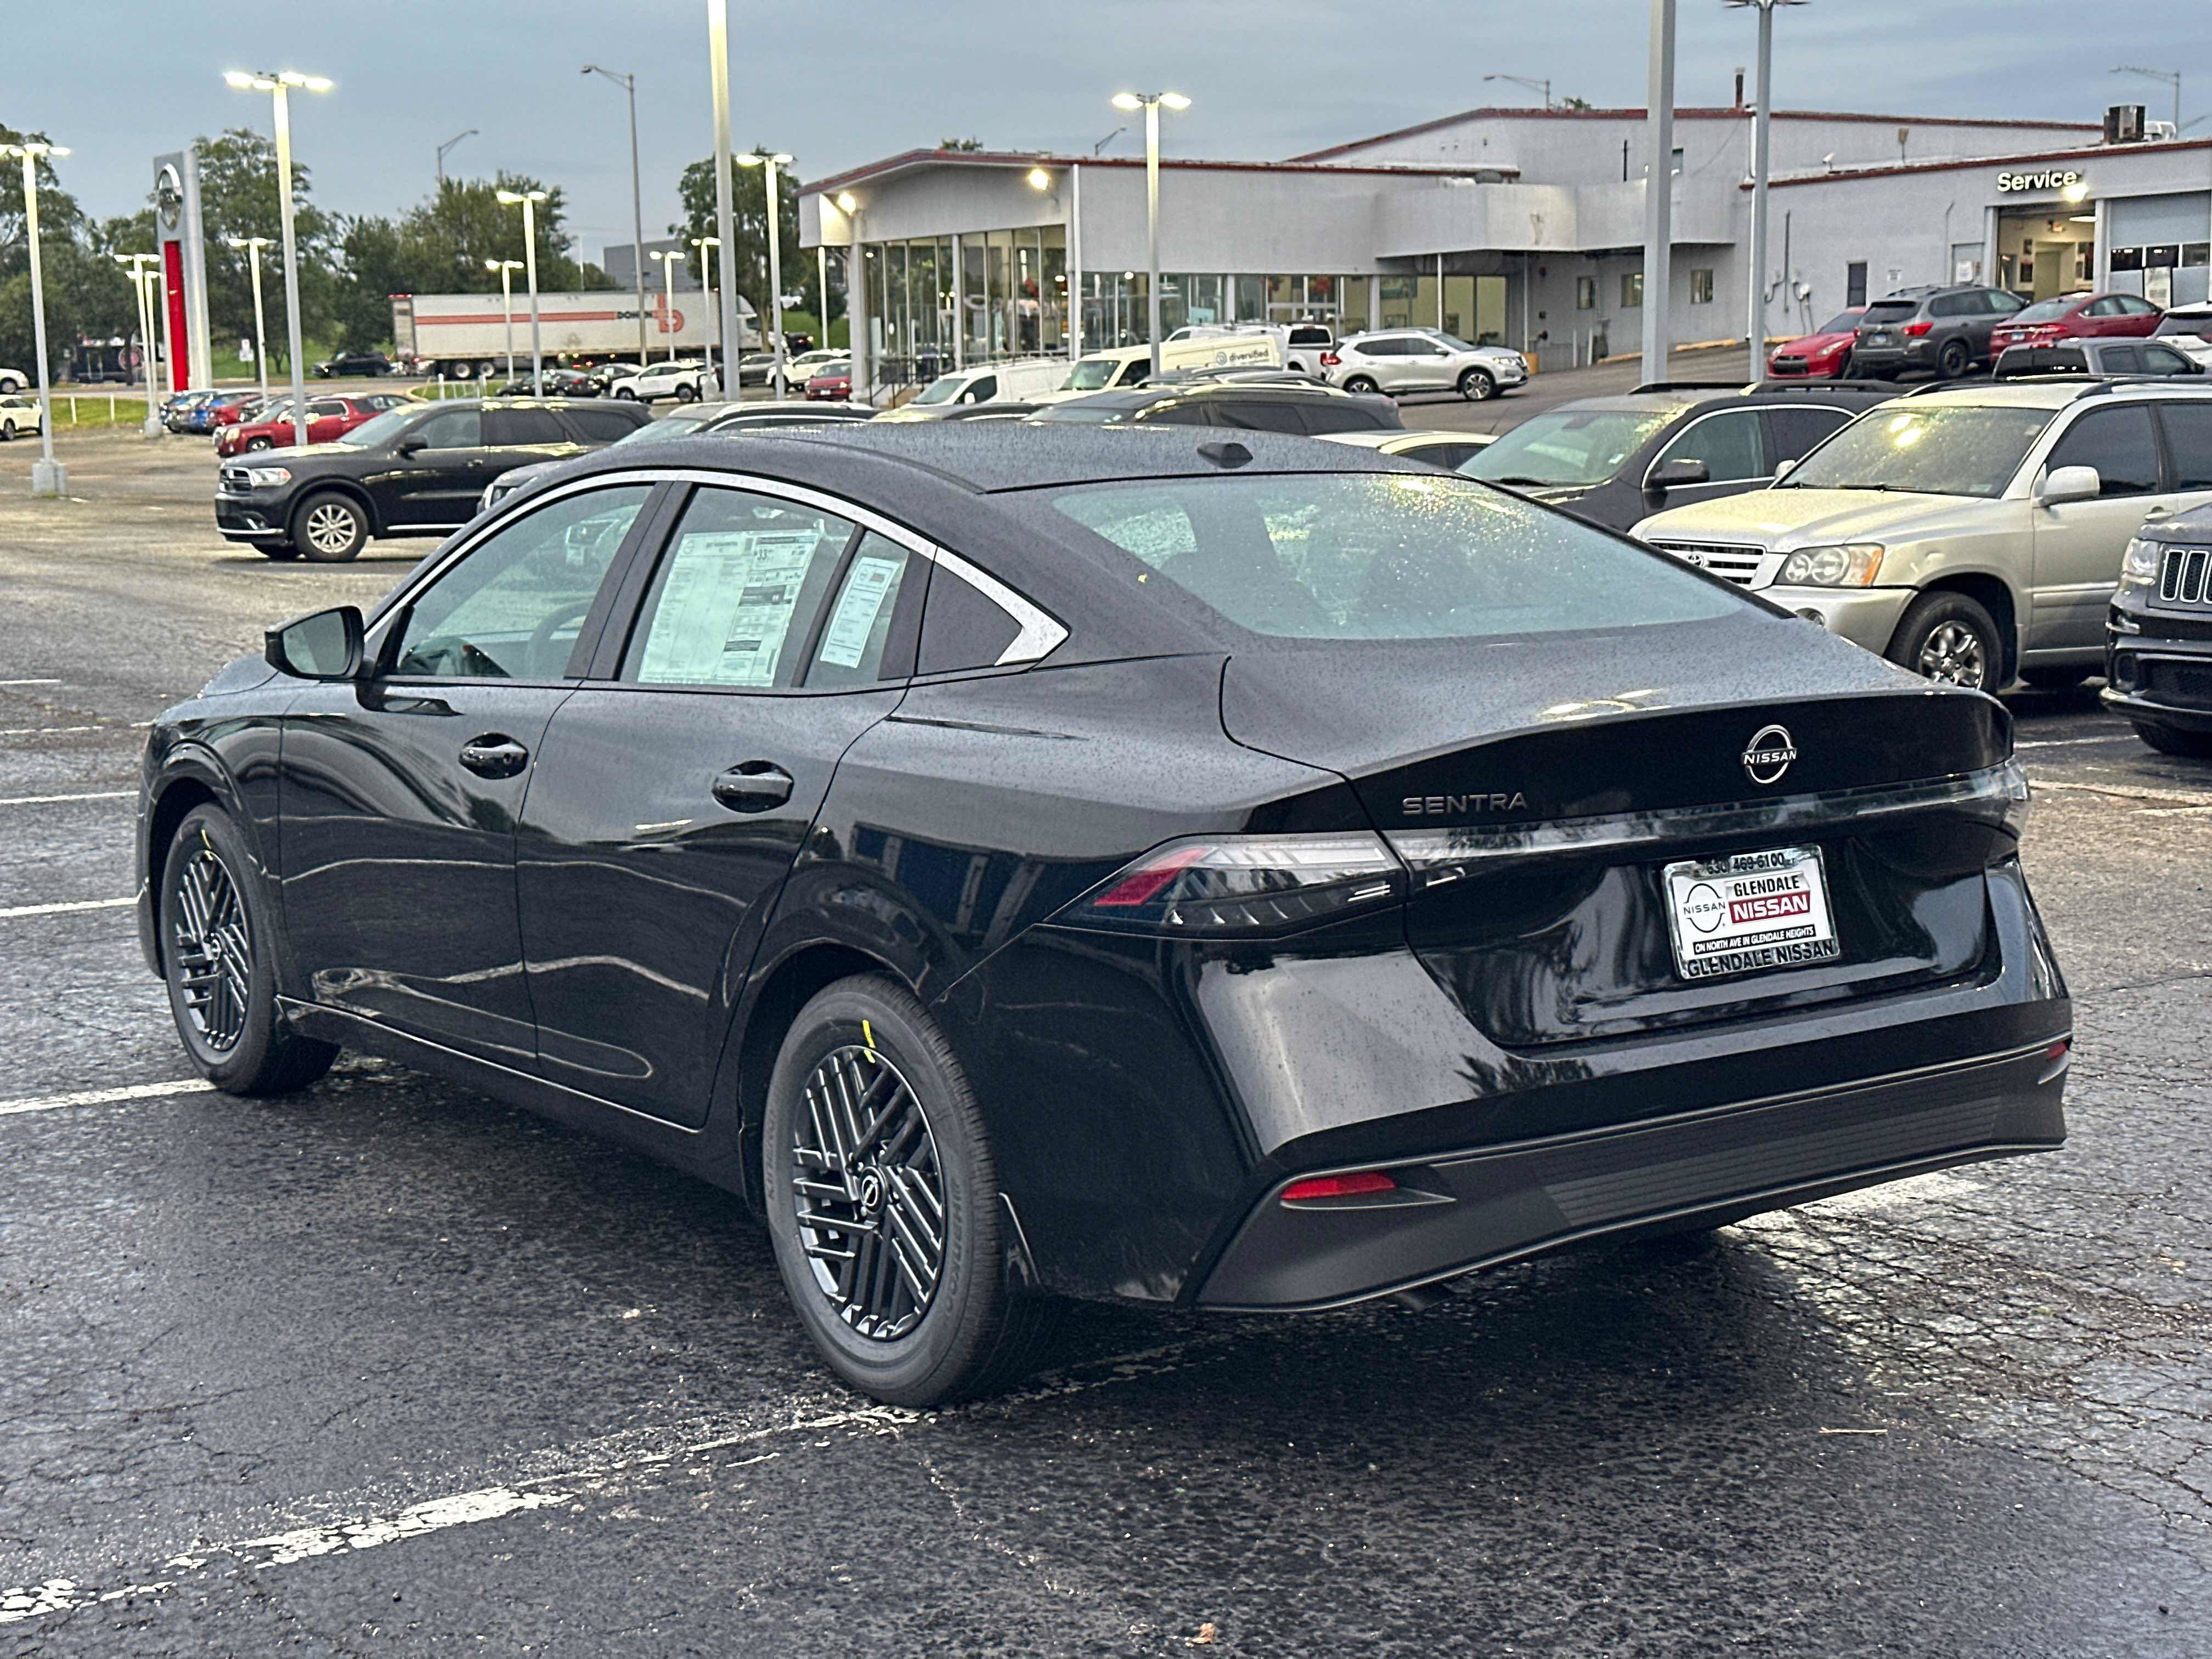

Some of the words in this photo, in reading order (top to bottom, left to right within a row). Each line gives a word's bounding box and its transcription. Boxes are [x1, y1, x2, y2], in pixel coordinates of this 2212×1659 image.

[1997, 170, 2077, 192] Service
[1743, 750, 1797, 764] NISSAN
[1403, 792, 1527, 815] SENTRA
[1734, 853, 1784, 871] 469-6100
[1734, 875, 1800, 897] GLENDALE
[1684, 901, 1726, 915] NISSAN
[1733, 894, 1809, 921] NISSAN
[1695, 943, 1706, 953] ON
[1706, 940, 1728, 951] NORTH
[1729, 938, 1742, 947] AVE
[1743, 936, 1750, 945] IN
[1751, 929, 1785, 944] GLENDALE
[1786, 926, 1814, 939] HEIGHTS
[1687, 950, 1773, 977] GLENDALE
[1775, 940, 1835, 963] NISSAN
